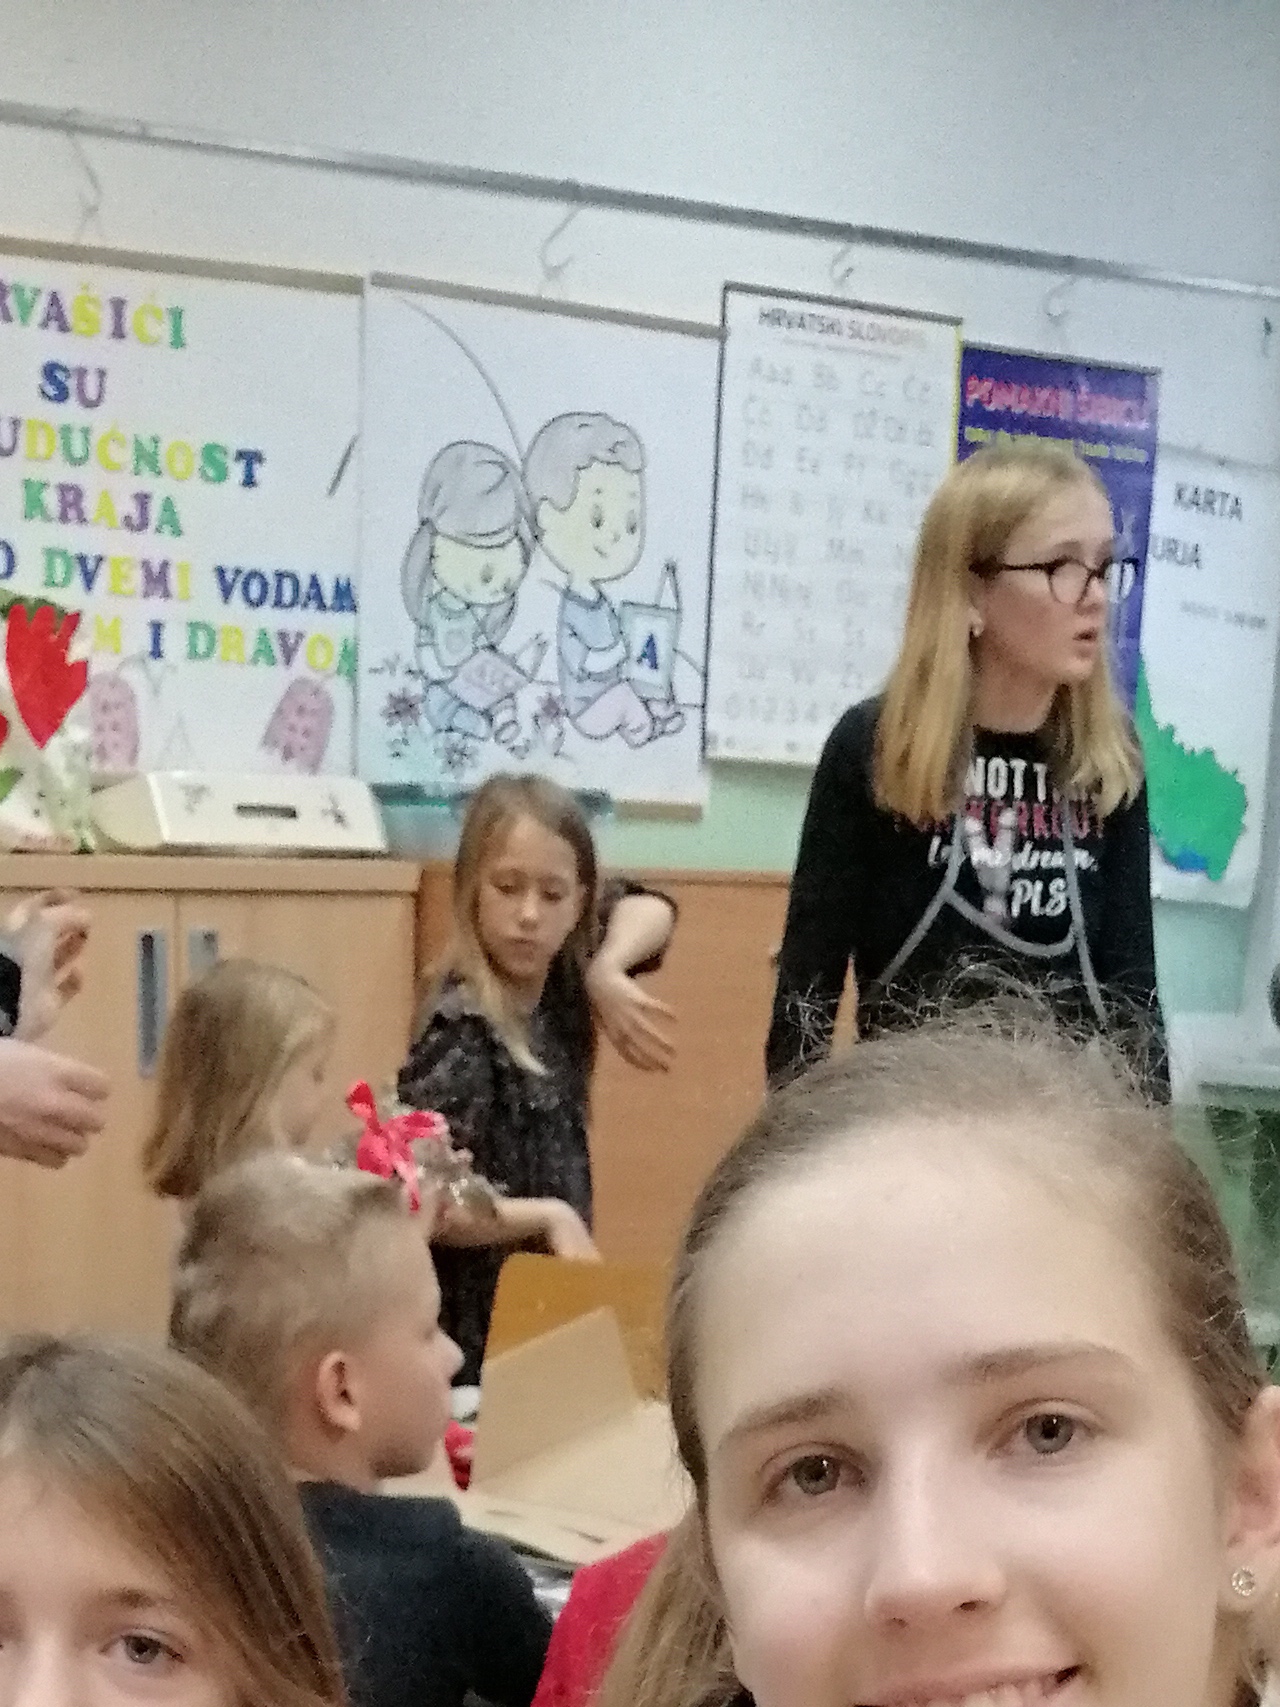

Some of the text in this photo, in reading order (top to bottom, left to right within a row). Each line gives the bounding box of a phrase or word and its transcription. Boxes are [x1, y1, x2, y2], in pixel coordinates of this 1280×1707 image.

[39, 361, 107, 408] SU
[22, 478, 184, 538] KRAJA
[1174, 482, 1244, 521] KARTA
[1149, 532, 1204, 570] URJA
[42, 547, 192, 601] DVEMI
[964, 756, 1027, 800] NOT
